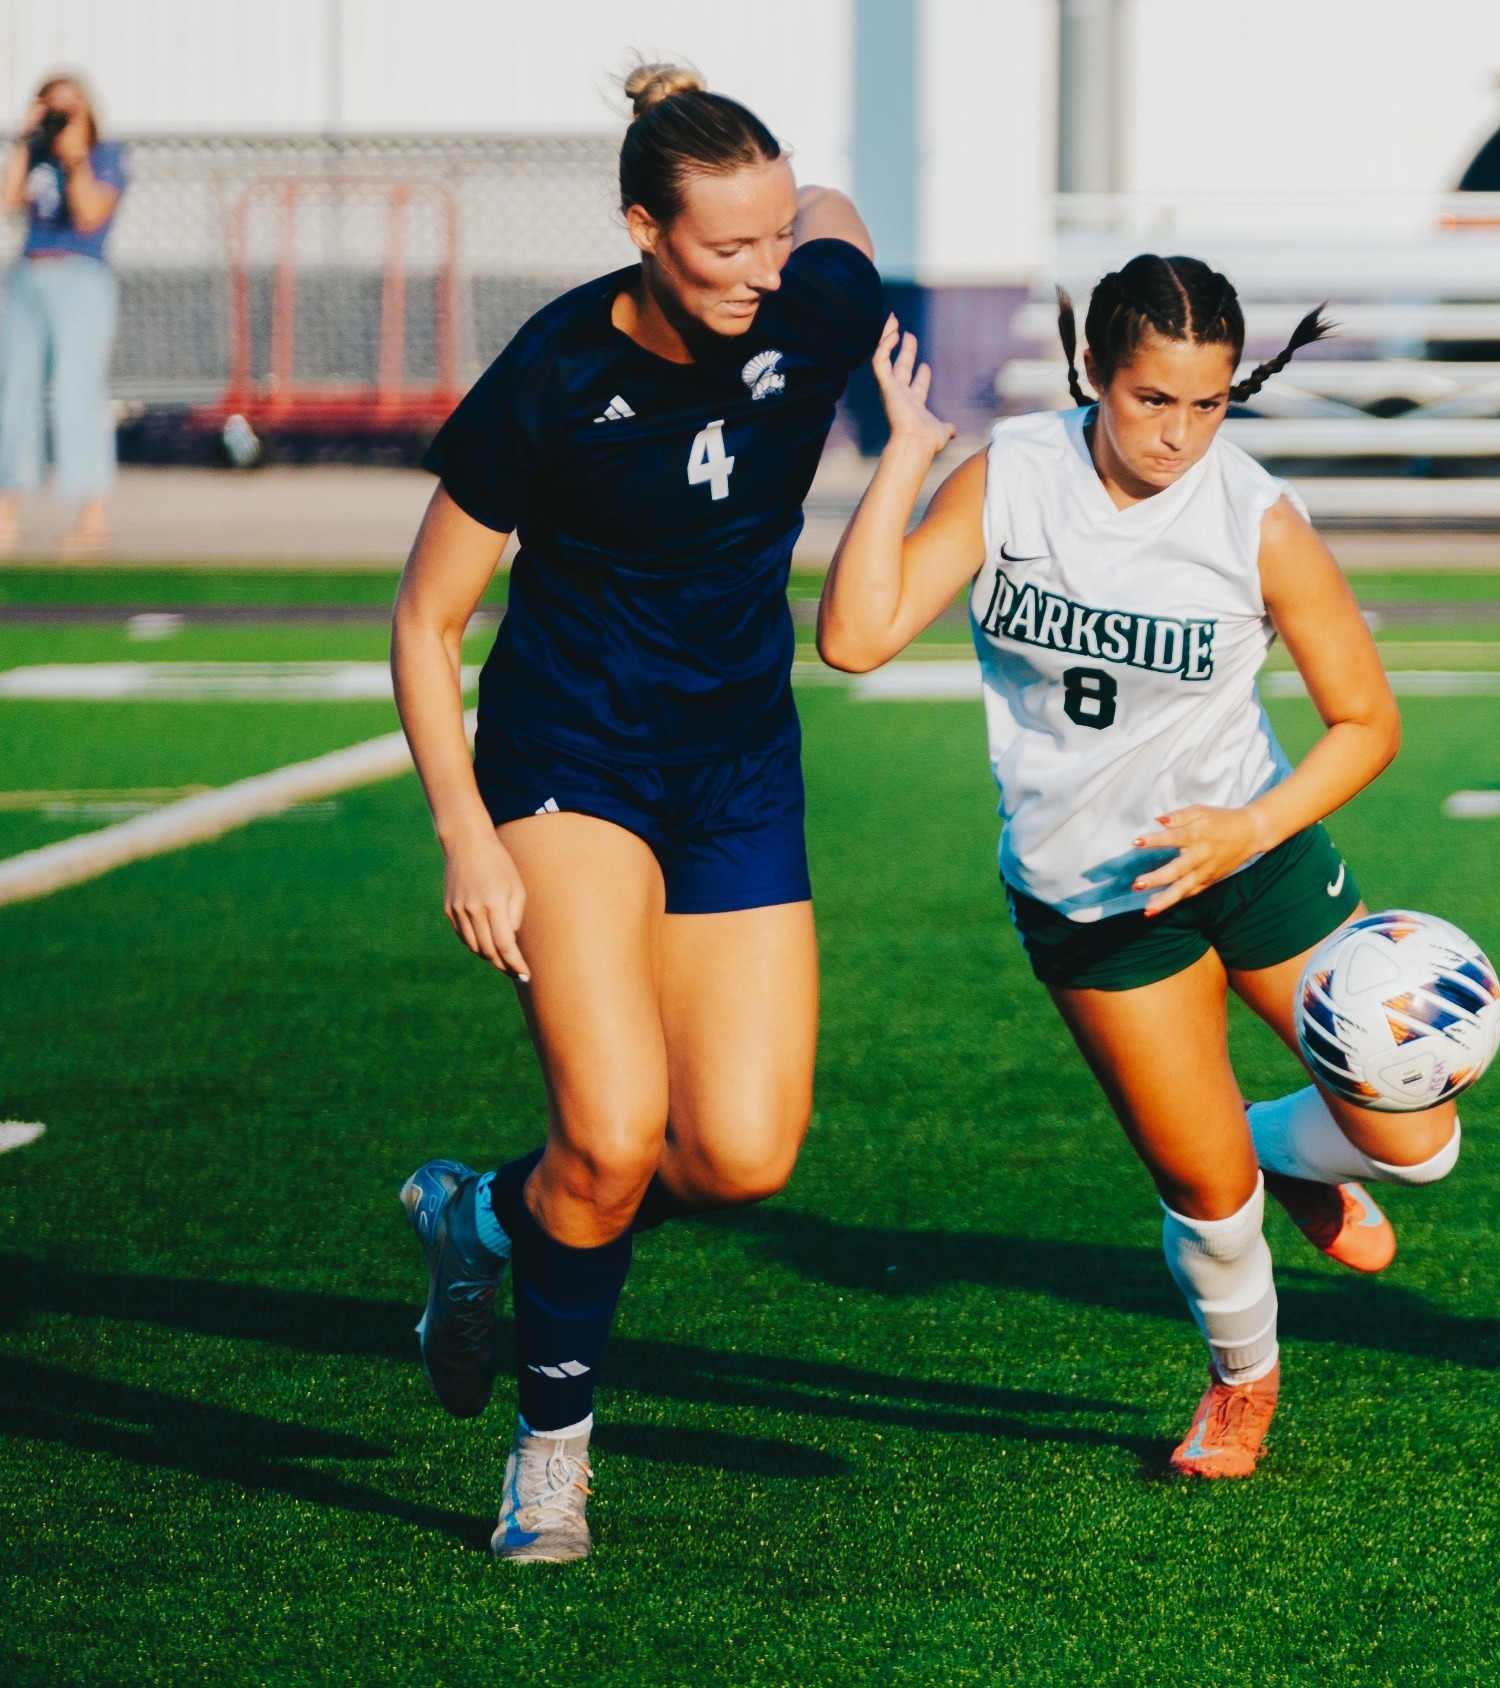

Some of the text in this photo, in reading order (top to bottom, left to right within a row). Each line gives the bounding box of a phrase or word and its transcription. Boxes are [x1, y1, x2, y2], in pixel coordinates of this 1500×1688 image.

[687, 419, 735, 500] 4
[981, 568, 1218, 681] PARKSIDE
[1063, 666, 1117, 731] 8
